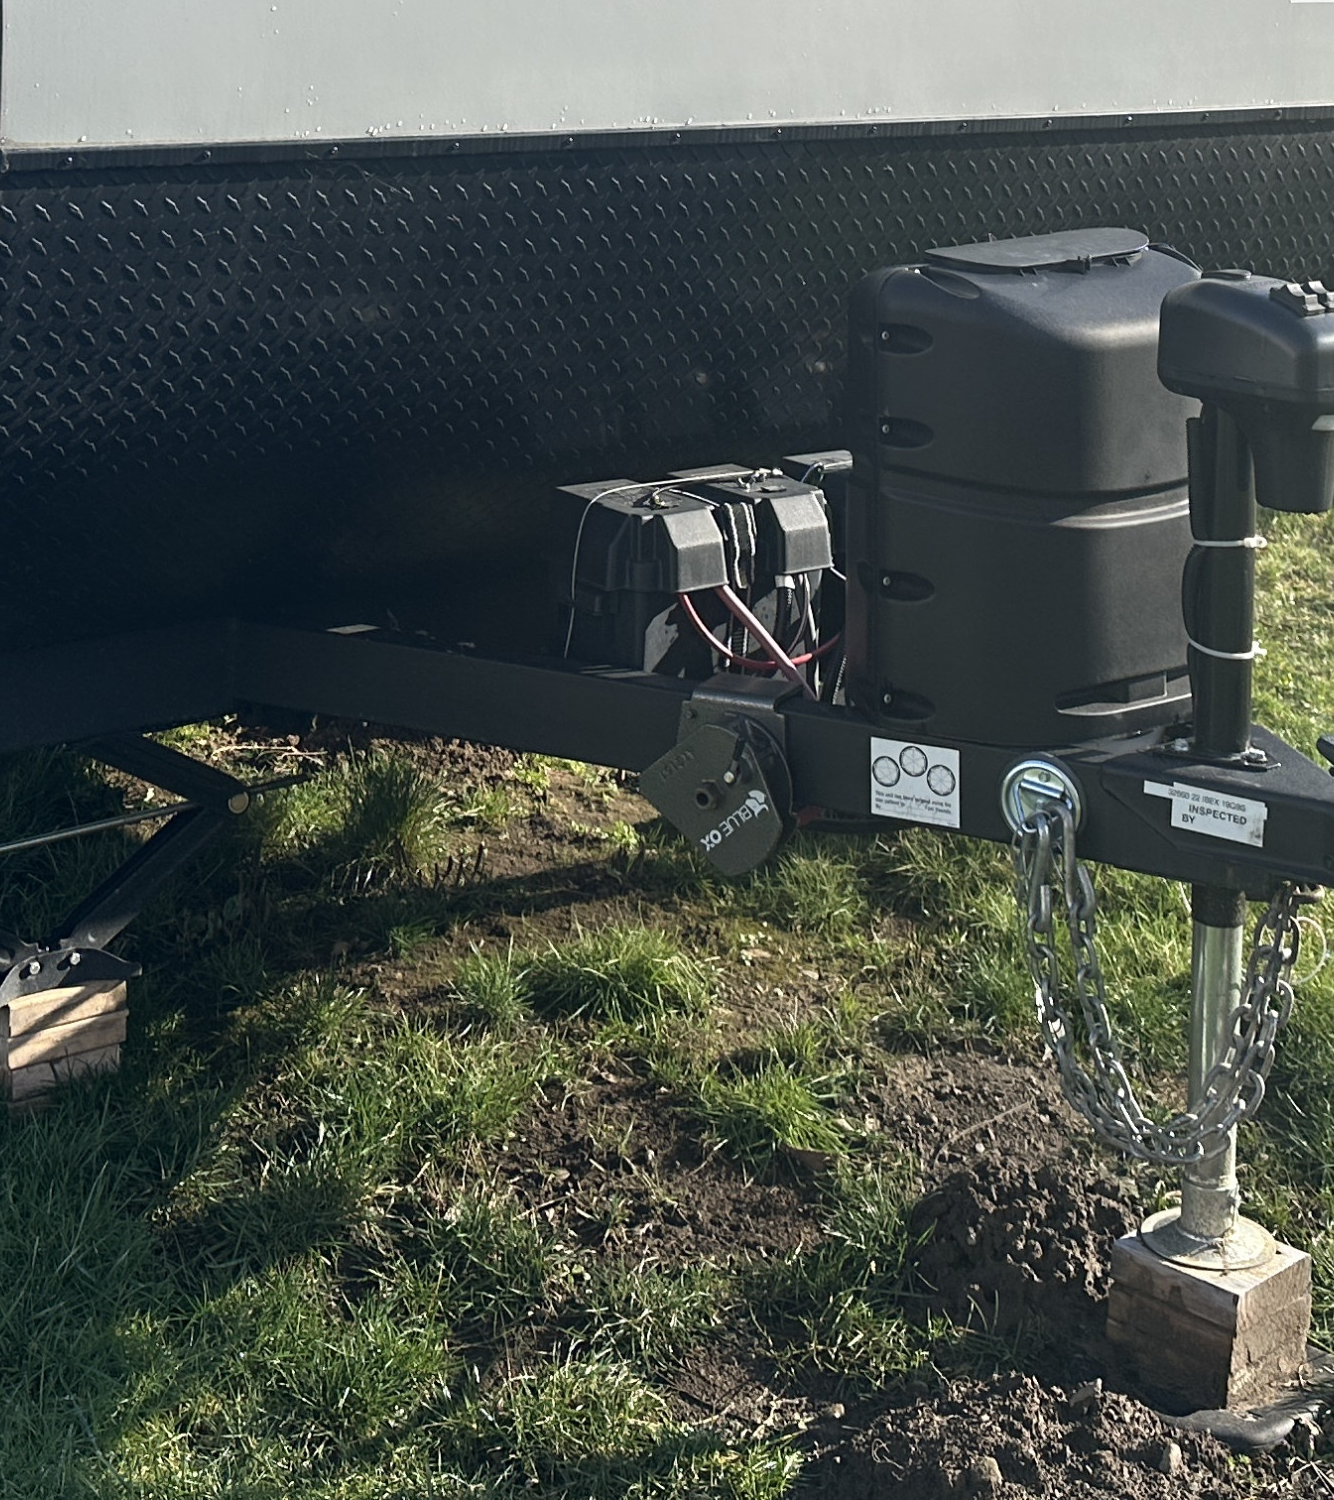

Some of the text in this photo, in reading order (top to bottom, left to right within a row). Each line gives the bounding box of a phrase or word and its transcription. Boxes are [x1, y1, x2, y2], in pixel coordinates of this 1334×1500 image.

[1181, 813, 1196, 824] BY
[1188, 804, 1247, 825] INSPECTED
[700, 804, 753, 852] BLUE OX
